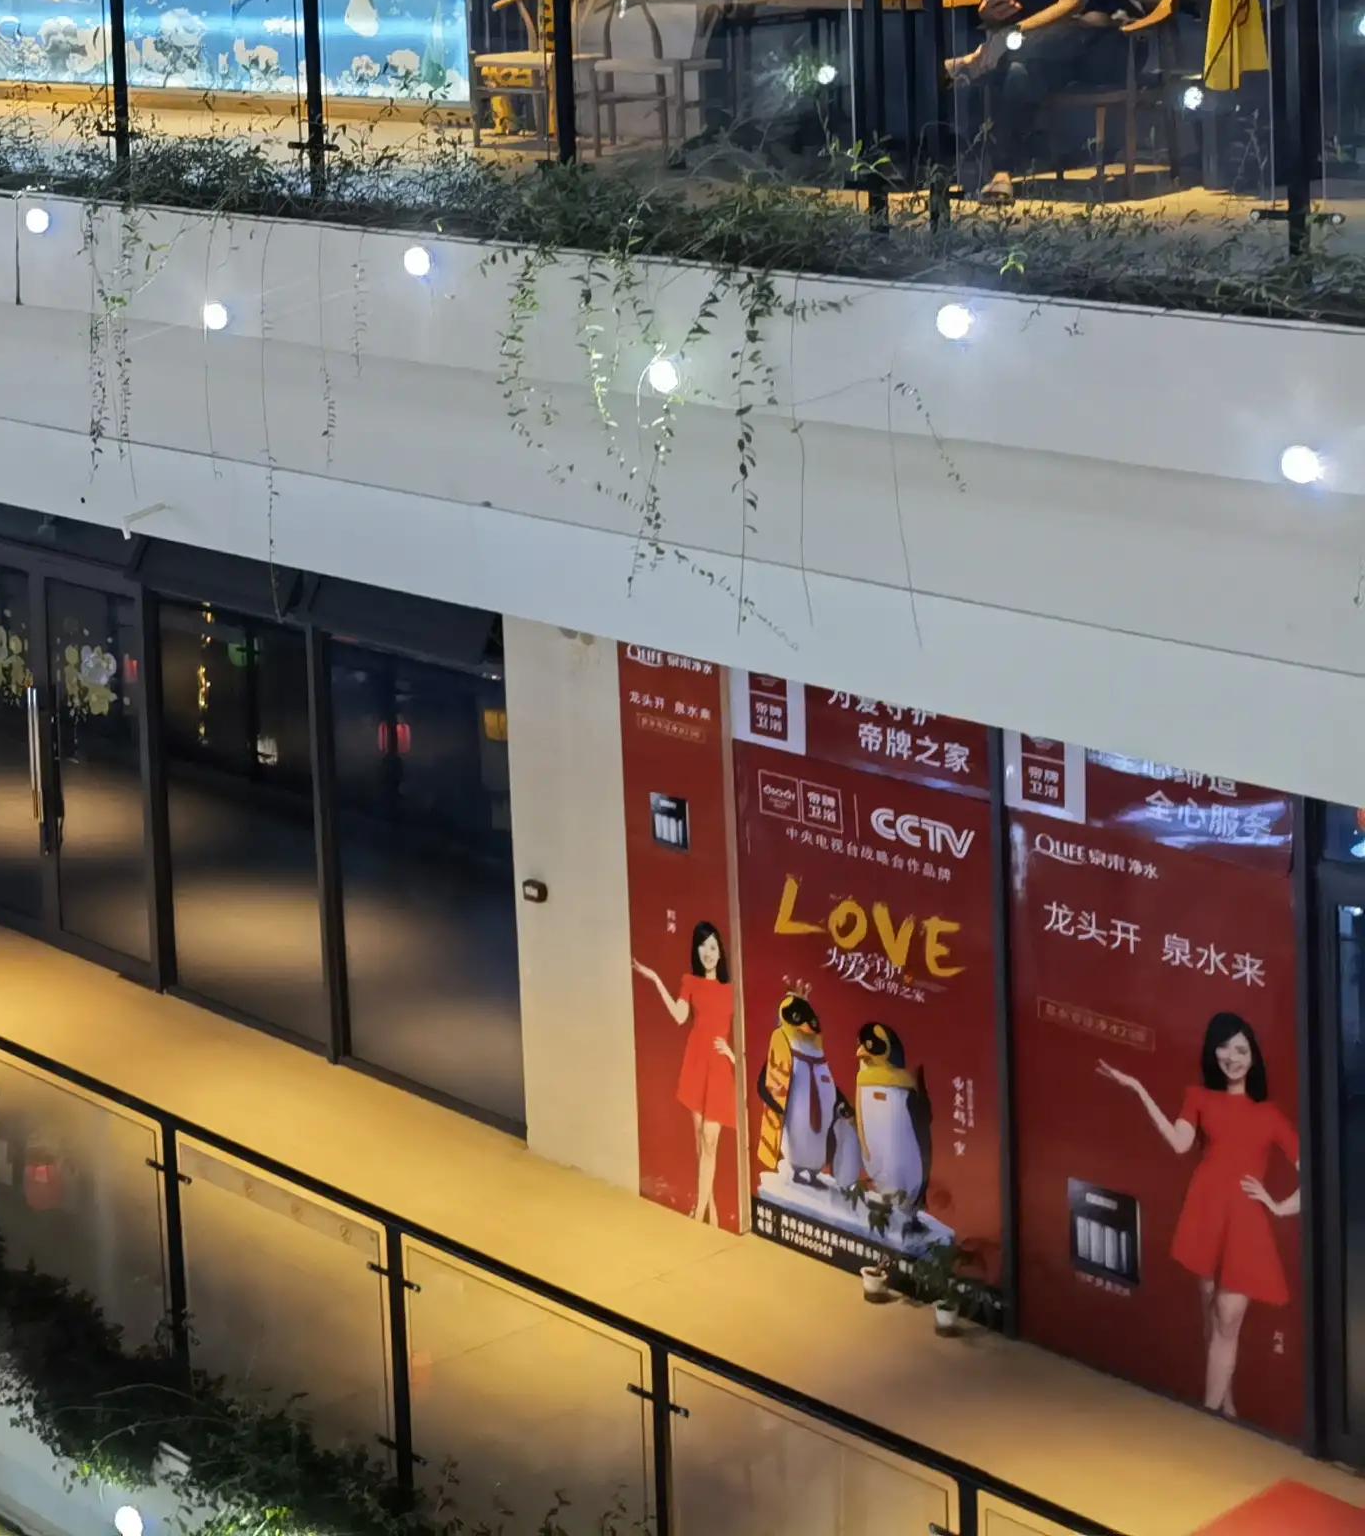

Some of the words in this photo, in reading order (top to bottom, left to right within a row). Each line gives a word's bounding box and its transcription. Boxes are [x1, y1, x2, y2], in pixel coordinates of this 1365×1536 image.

[858, 722, 971, 774] 帝牌之家
[870, 808, 975, 859] CCTV
[1144, 790, 1272, 839] 全心服务
[785, 826, 952, 883] 中央电视台战略合作品牌
[774, 873, 966, 977] LOVE
[1043, 900, 1142, 954] 龙头开
[1161, 933, 1266, 987] 泉水来
